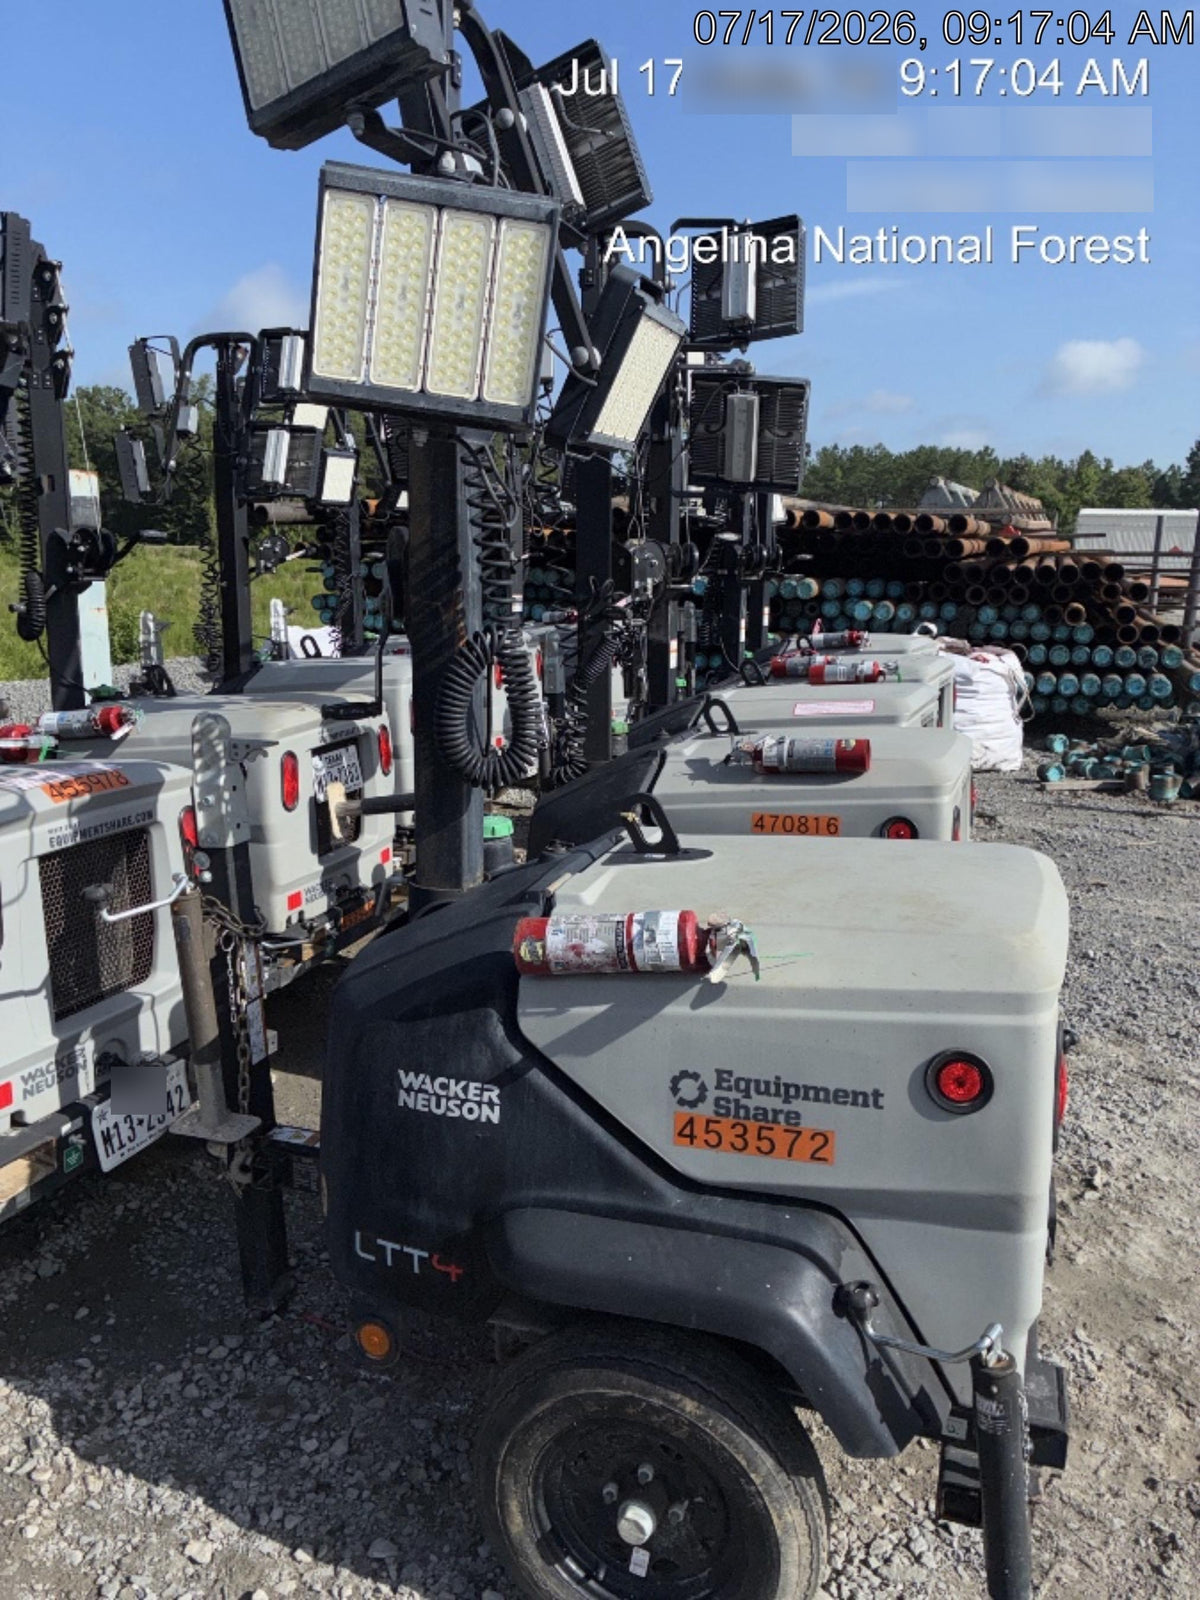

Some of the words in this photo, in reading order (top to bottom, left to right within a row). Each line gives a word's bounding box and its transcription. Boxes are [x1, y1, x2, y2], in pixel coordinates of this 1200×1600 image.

[48, 768, 130, 798] 455978
[752, 813, 840, 836] 470816
[397, 1069, 501, 1104] WACKER
[713, 1068, 885, 1110] Equipment
[397, 1089, 500, 1124] NEUSON
[713, 1096, 802, 1127] Share
[676, 1116, 830, 1163] 453572
